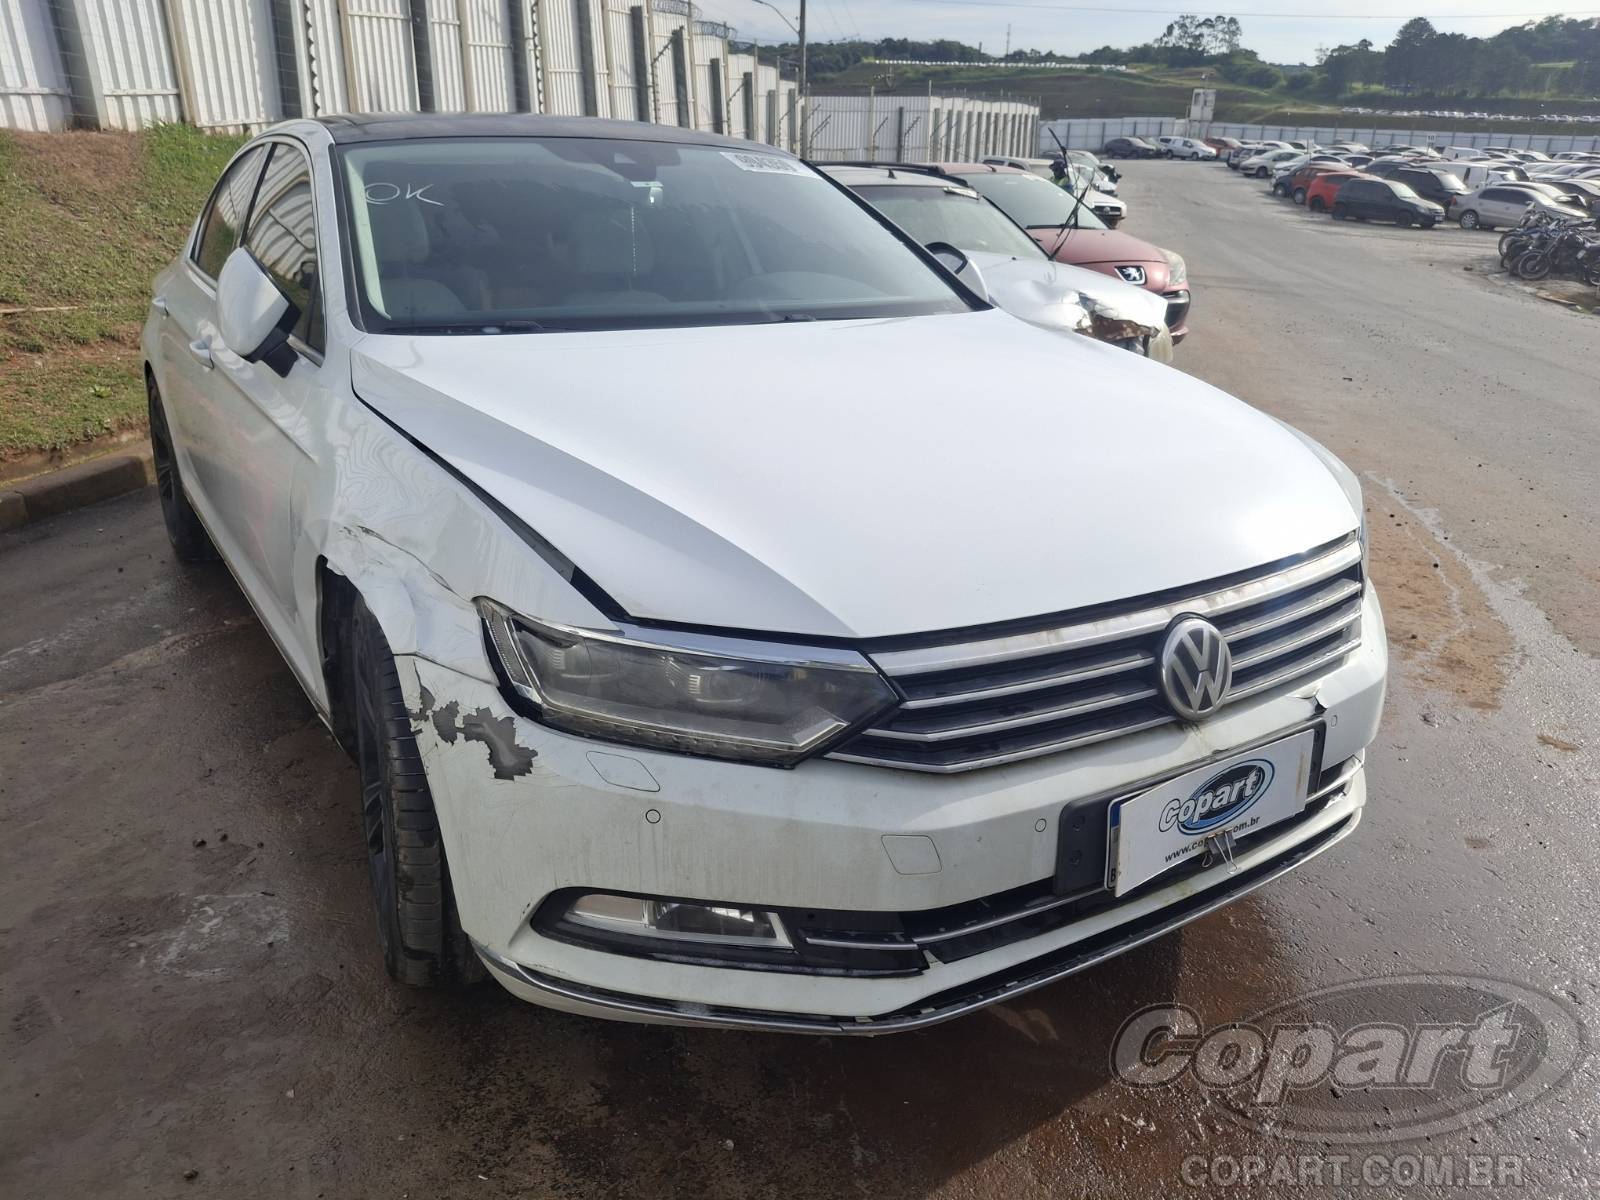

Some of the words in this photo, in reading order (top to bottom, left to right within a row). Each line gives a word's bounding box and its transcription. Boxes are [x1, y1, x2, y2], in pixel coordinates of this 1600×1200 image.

[364, 182, 445, 207] OK
[1164, 618, 1231, 718] VW
[1159, 768, 1262, 832] Copart
[1165, 816, 1260, 862] www.copom.br
